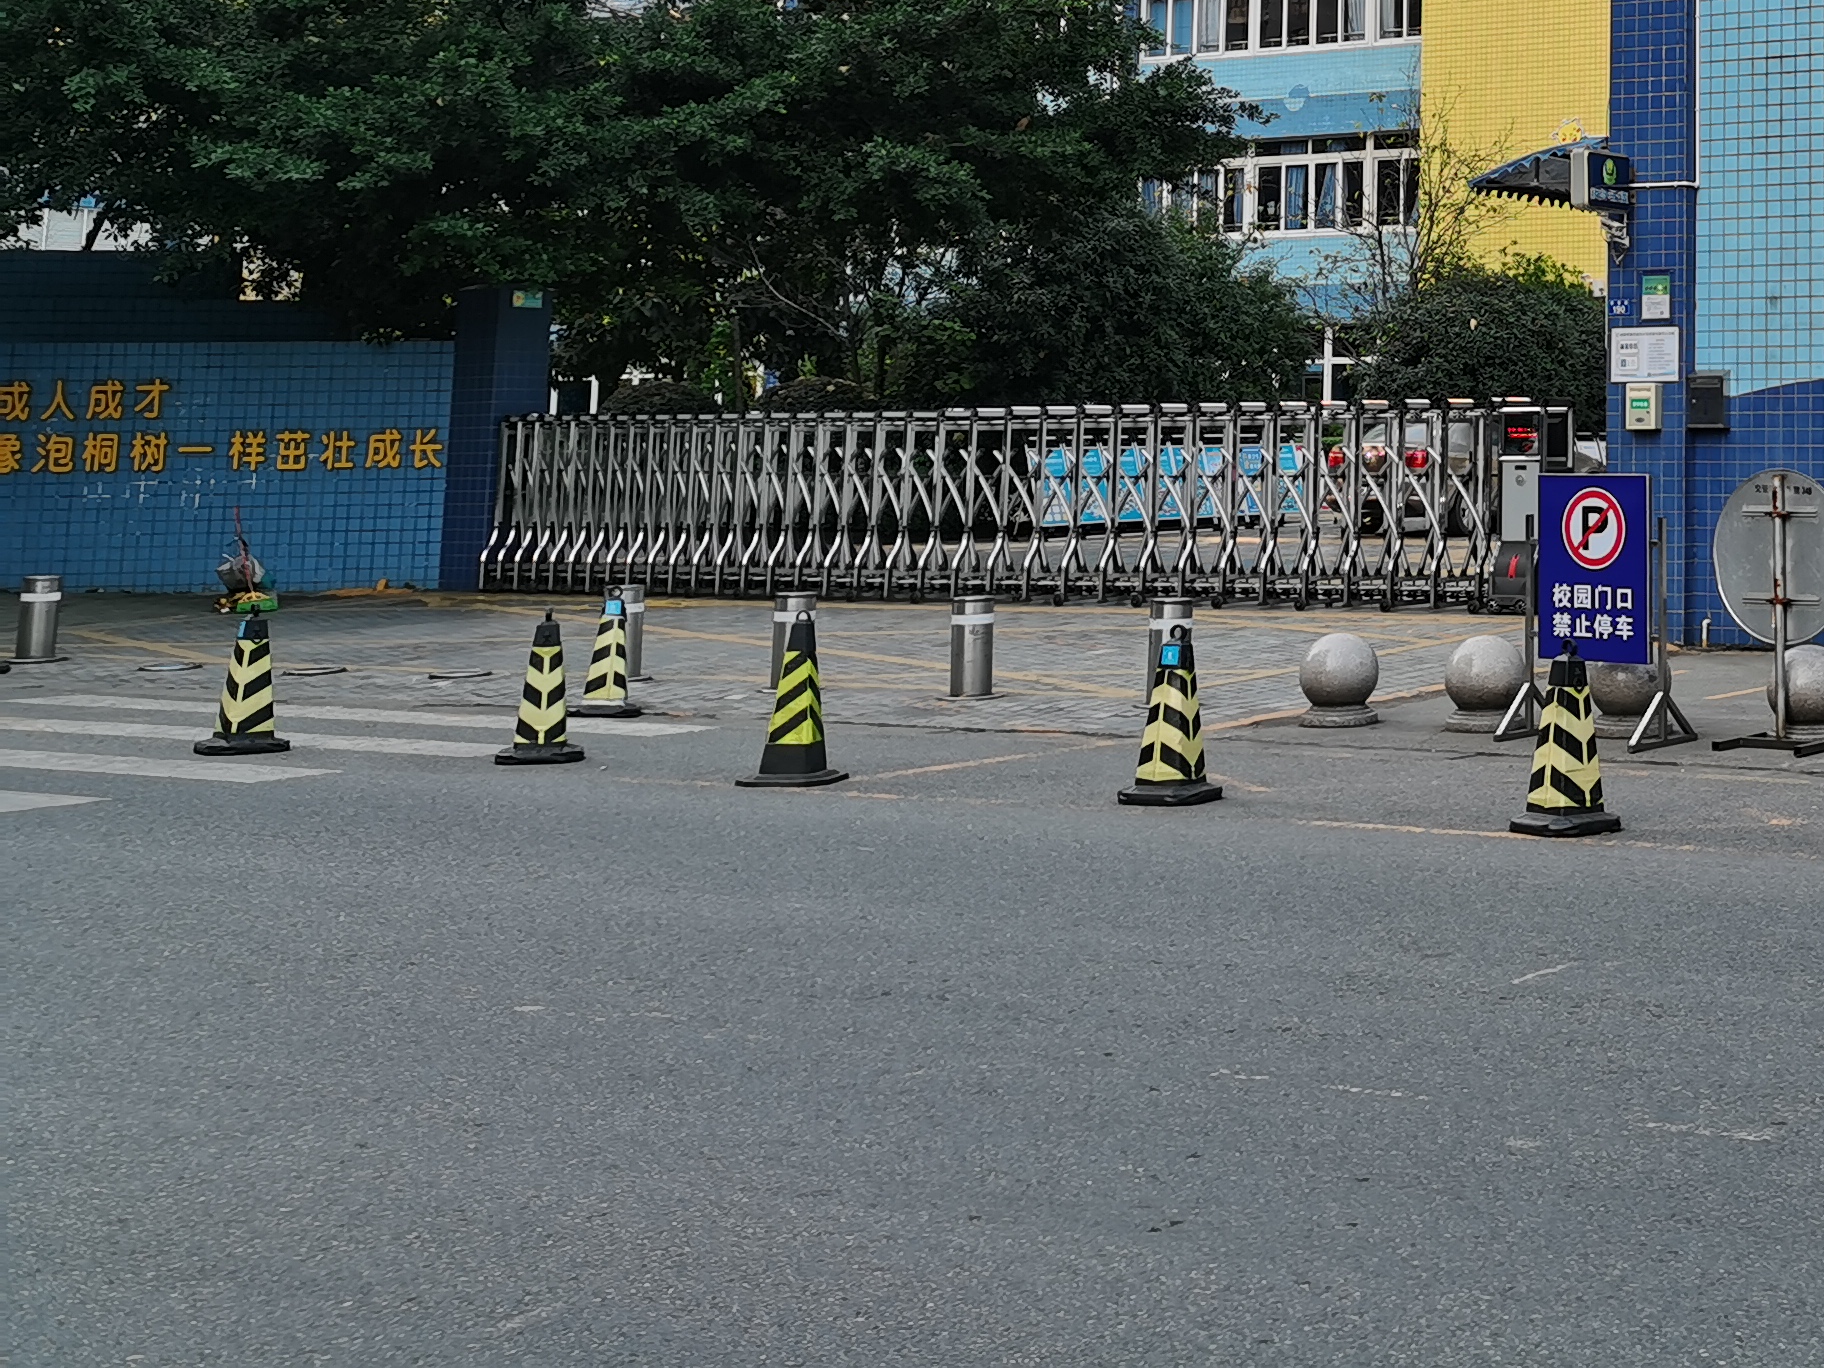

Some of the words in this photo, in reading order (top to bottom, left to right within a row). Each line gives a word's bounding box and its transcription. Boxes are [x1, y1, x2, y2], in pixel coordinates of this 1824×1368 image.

[0, 378, 170, 421] 成人成才
[1581, 505, 1609, 551] P
[1551, 582, 1634, 610] 校园门口
[1551, 612, 1636, 641] 禁止停车
